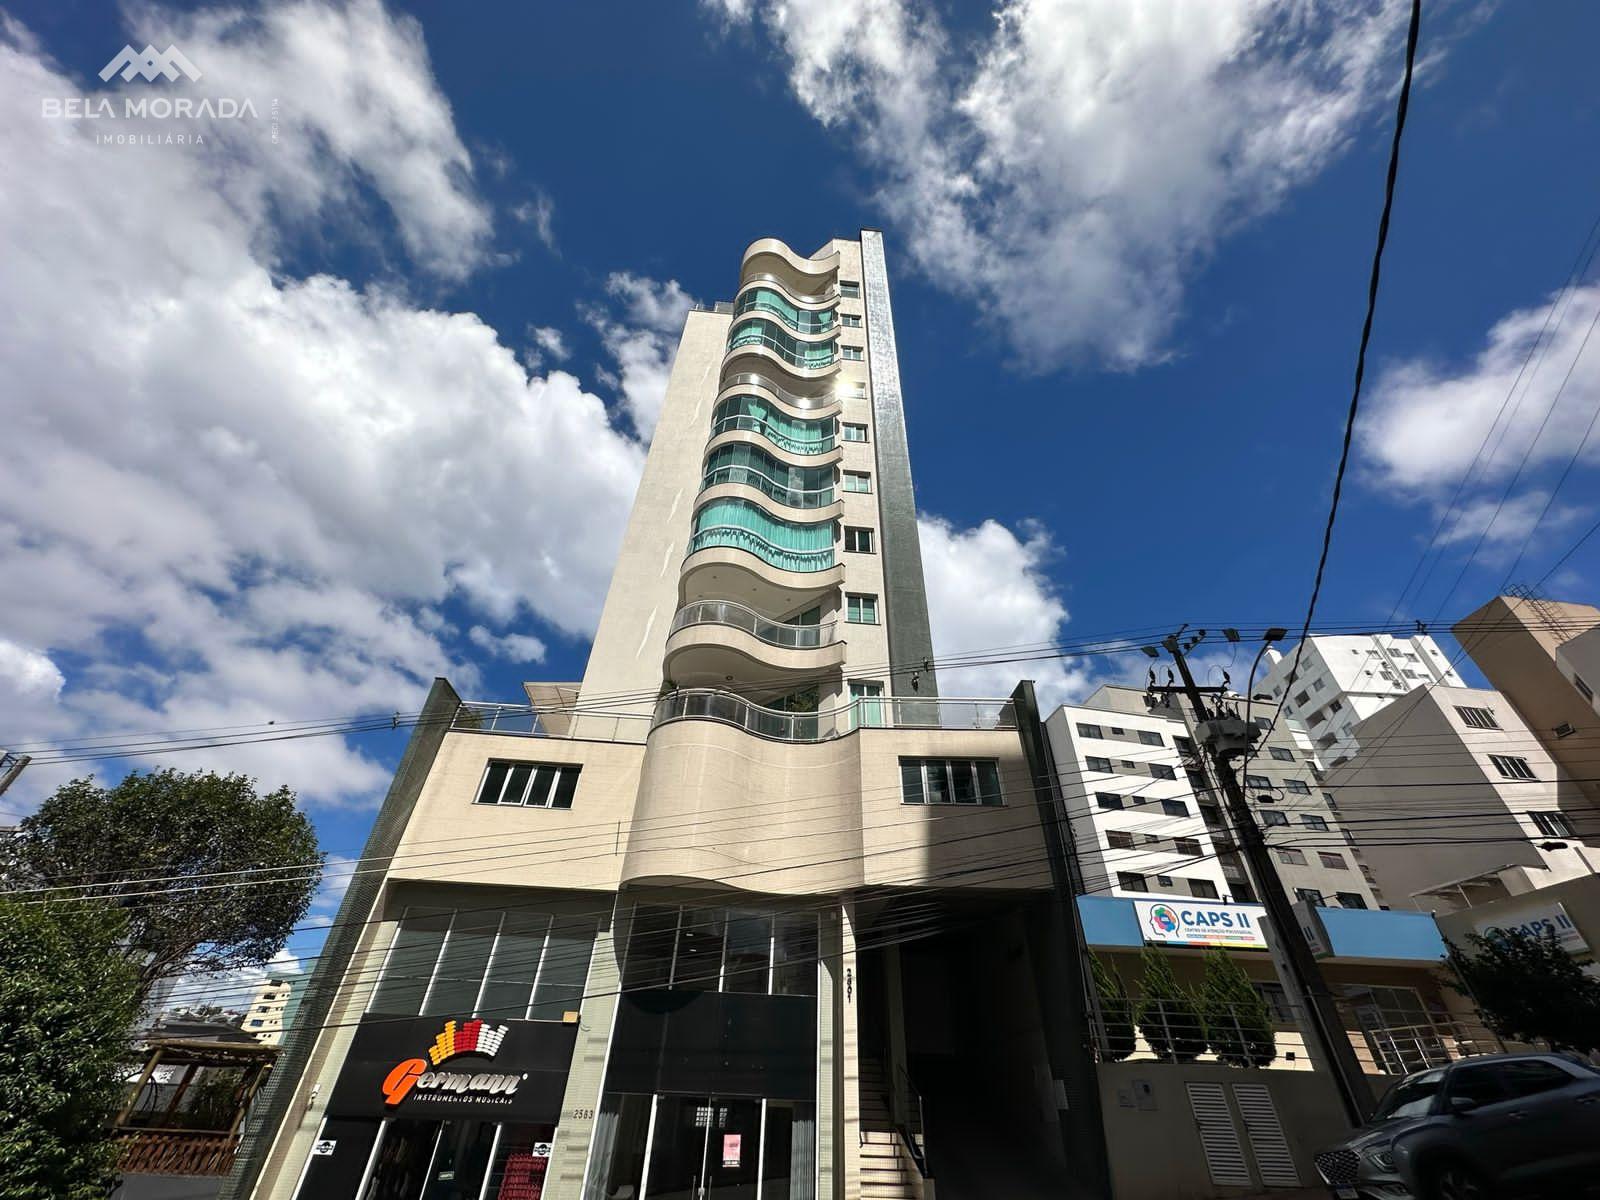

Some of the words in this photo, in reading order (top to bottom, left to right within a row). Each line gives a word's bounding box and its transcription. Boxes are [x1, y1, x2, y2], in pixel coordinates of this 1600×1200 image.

[1181, 910, 1233, 927] CAPS
[1236, 912, 1251, 928] II
[382, 1058, 521, 1105] Germann
[413, 1093, 473, 1103] INSTRUMENTOS
